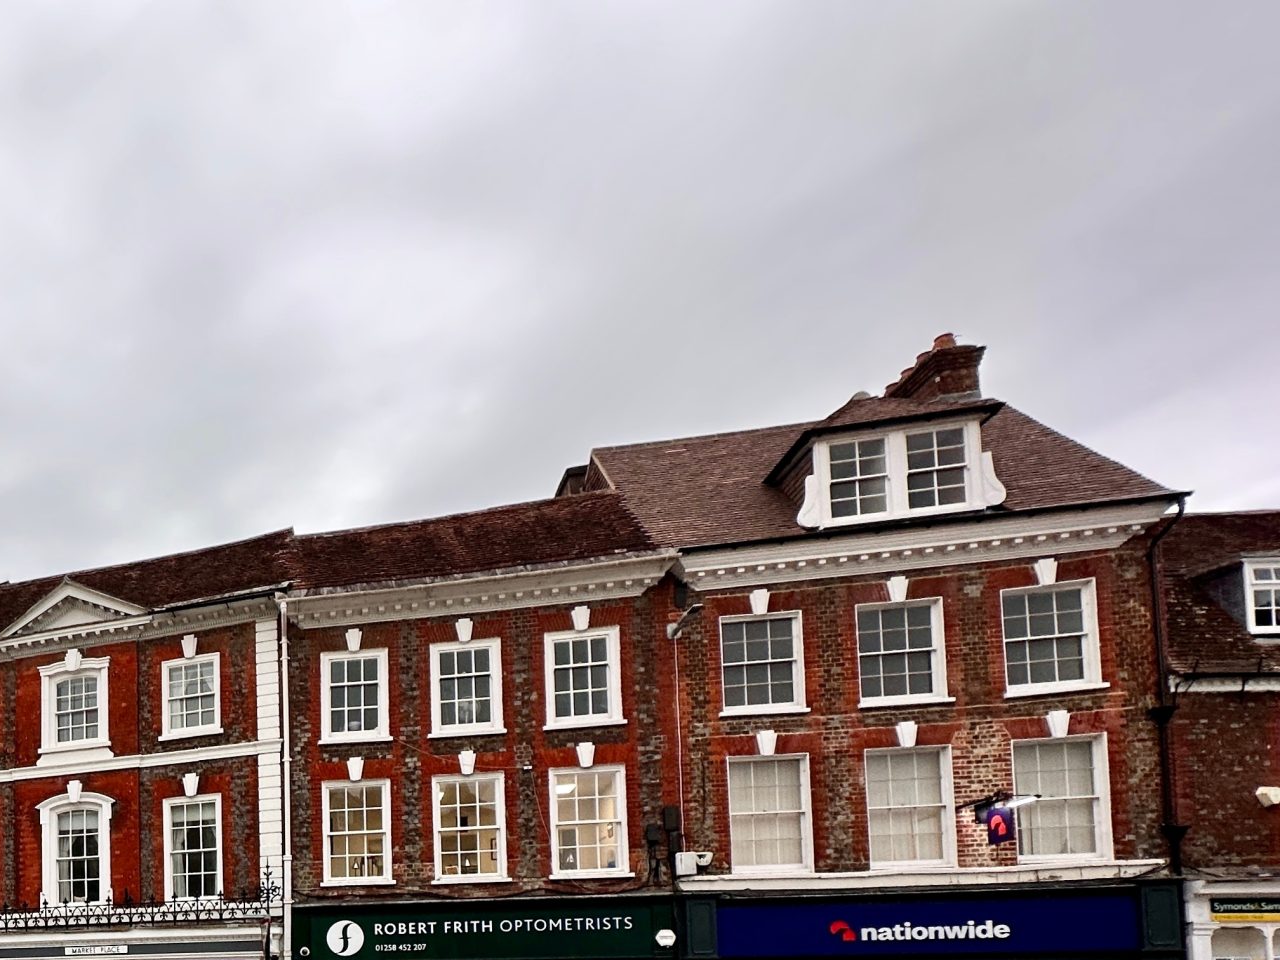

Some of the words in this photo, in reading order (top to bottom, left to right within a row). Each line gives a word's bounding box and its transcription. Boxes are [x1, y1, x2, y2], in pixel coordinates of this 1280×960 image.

[1214, 902, 1254, 912] Symonds
[374, 922, 437, 935] ROBERT
[444, 920, 493, 933] FRITH
[499, 916, 633, 932] OPTOMETRISTS
[861, 920, 1010, 941] nationwide
[413, 943, 426, 951] 207
